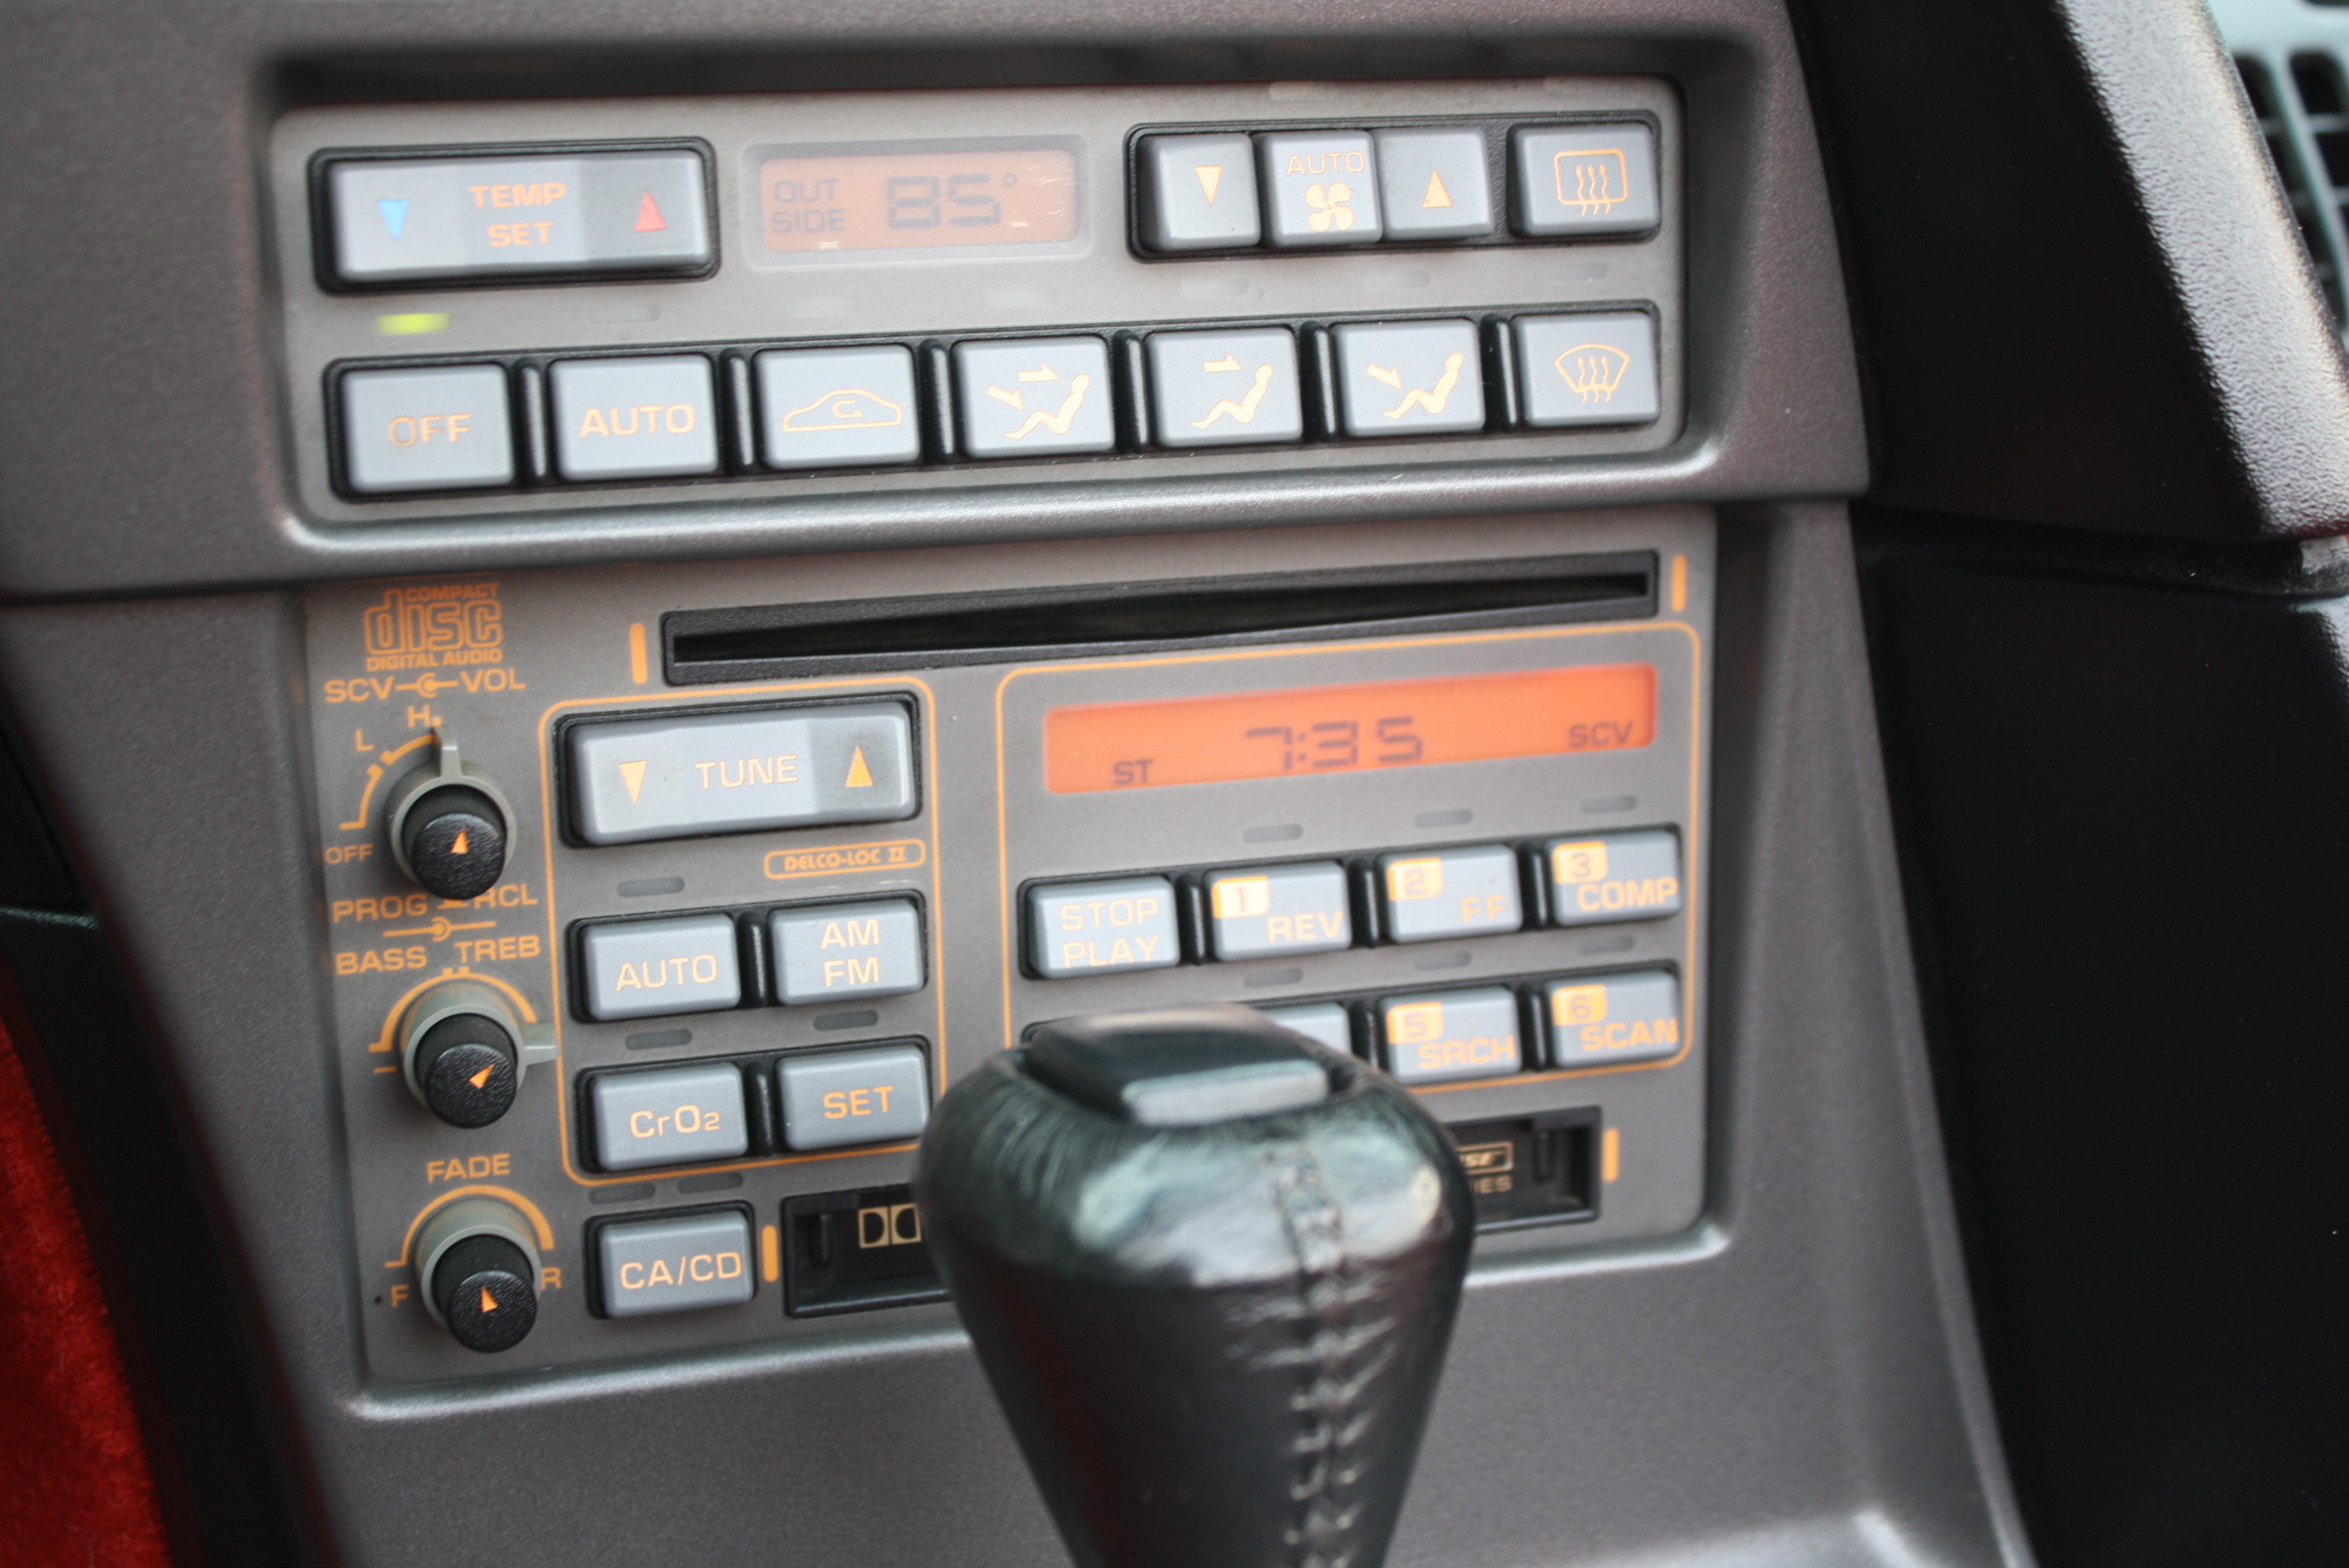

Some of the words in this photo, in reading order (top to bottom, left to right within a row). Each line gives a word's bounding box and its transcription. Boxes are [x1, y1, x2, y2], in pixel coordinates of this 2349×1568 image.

[1285, 151, 1366, 176] AUTO
[468, 181, 566, 209] TEMP
[772, 178, 841, 204] OUT
[487, 221, 553, 247] SET
[771, 208, 848, 235] SIDE
[387, 413, 472, 447] OFF
[579, 402, 697, 438] AUTO
[405, 584, 500, 602] COMPACT
[366, 652, 439, 671] DIGITAL
[443, 648, 503, 666] AUDIO
[324, 676, 395, 703] SCV
[460, 668, 526, 694] VOL
[355, 729, 374, 751] L
[1244, 716, 1424, 771] 7:35
[1568, 720, 1635, 750] SCV
[694, 754, 799, 790] TUNE
[1113, 758, 1154, 785] ST
[325, 844, 373, 865] OFF
[783, 847, 881, 872] DELCO-LOC
[1570, 852, 1592, 878] 3
[1404, 868, 1427, 897] 2
[1577, 877, 1680, 912] COMP
[332, 893, 429, 923] PROG
[1059, 897, 1160, 932] STOP
[1461, 895, 1506, 923] FF
[820, 917, 880, 949] AM
[1266, 910, 1345, 944] REV
[335, 946, 428, 975] BASS
[454, 935, 541, 962] TREB
[1062, 934, 1161, 968] PLAY
[616, 953, 718, 992] AUTO
[823, 956, 881, 987] FM
[1571, 996, 1592, 1020] 6
[1404, 1010, 1427, 1038] 5
[1580, 1018, 1680, 1051] SCAN
[1417, 1035, 1517, 1070] SRCH
[822, 1085, 895, 1119] SET
[425, 1153, 511, 1183] FADE
[541, 1267, 562, 1290] R
[620, 1252, 742, 1290] CA/CD
[390, 1284, 410, 1308] F
